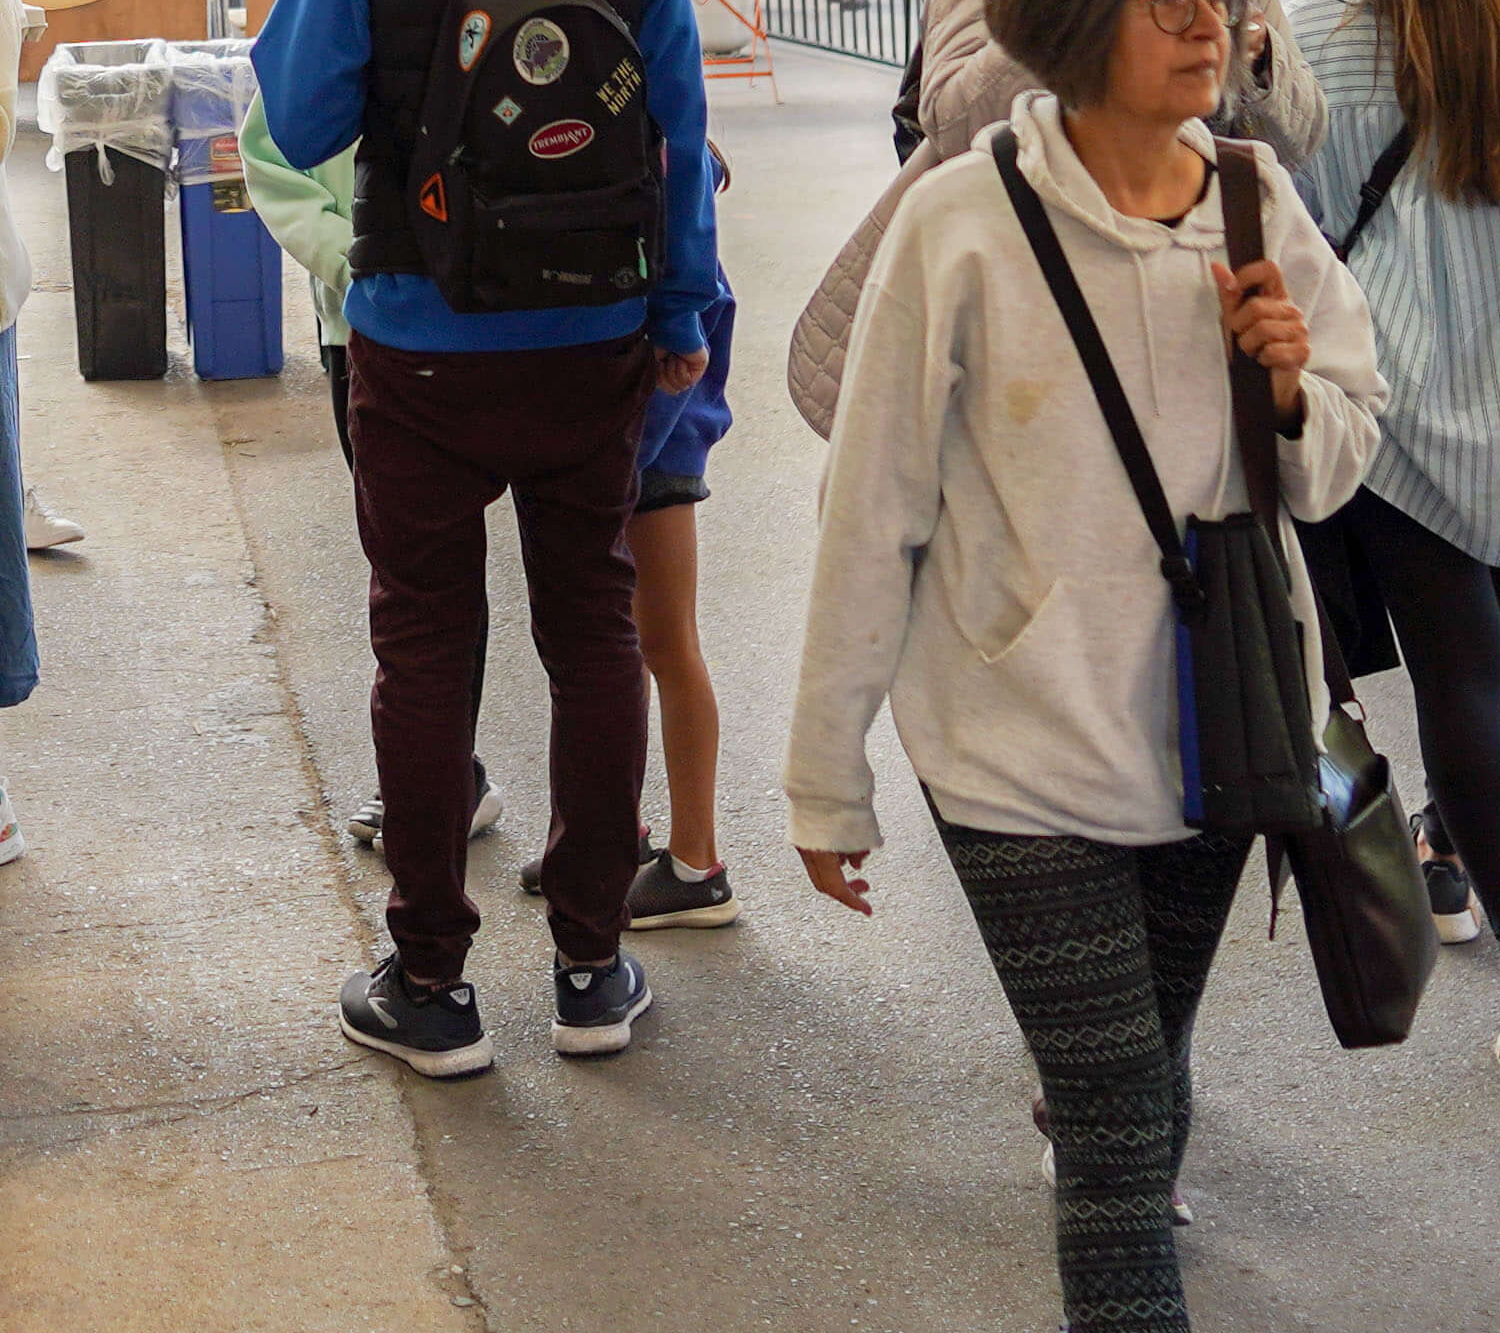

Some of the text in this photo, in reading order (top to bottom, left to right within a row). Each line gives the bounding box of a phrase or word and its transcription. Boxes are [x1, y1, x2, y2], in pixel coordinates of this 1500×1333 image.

[596, 57, 634, 102] WE THE
[607, 69, 642, 116] NORTH
[533, 127, 588, 150] TREMBLANT
